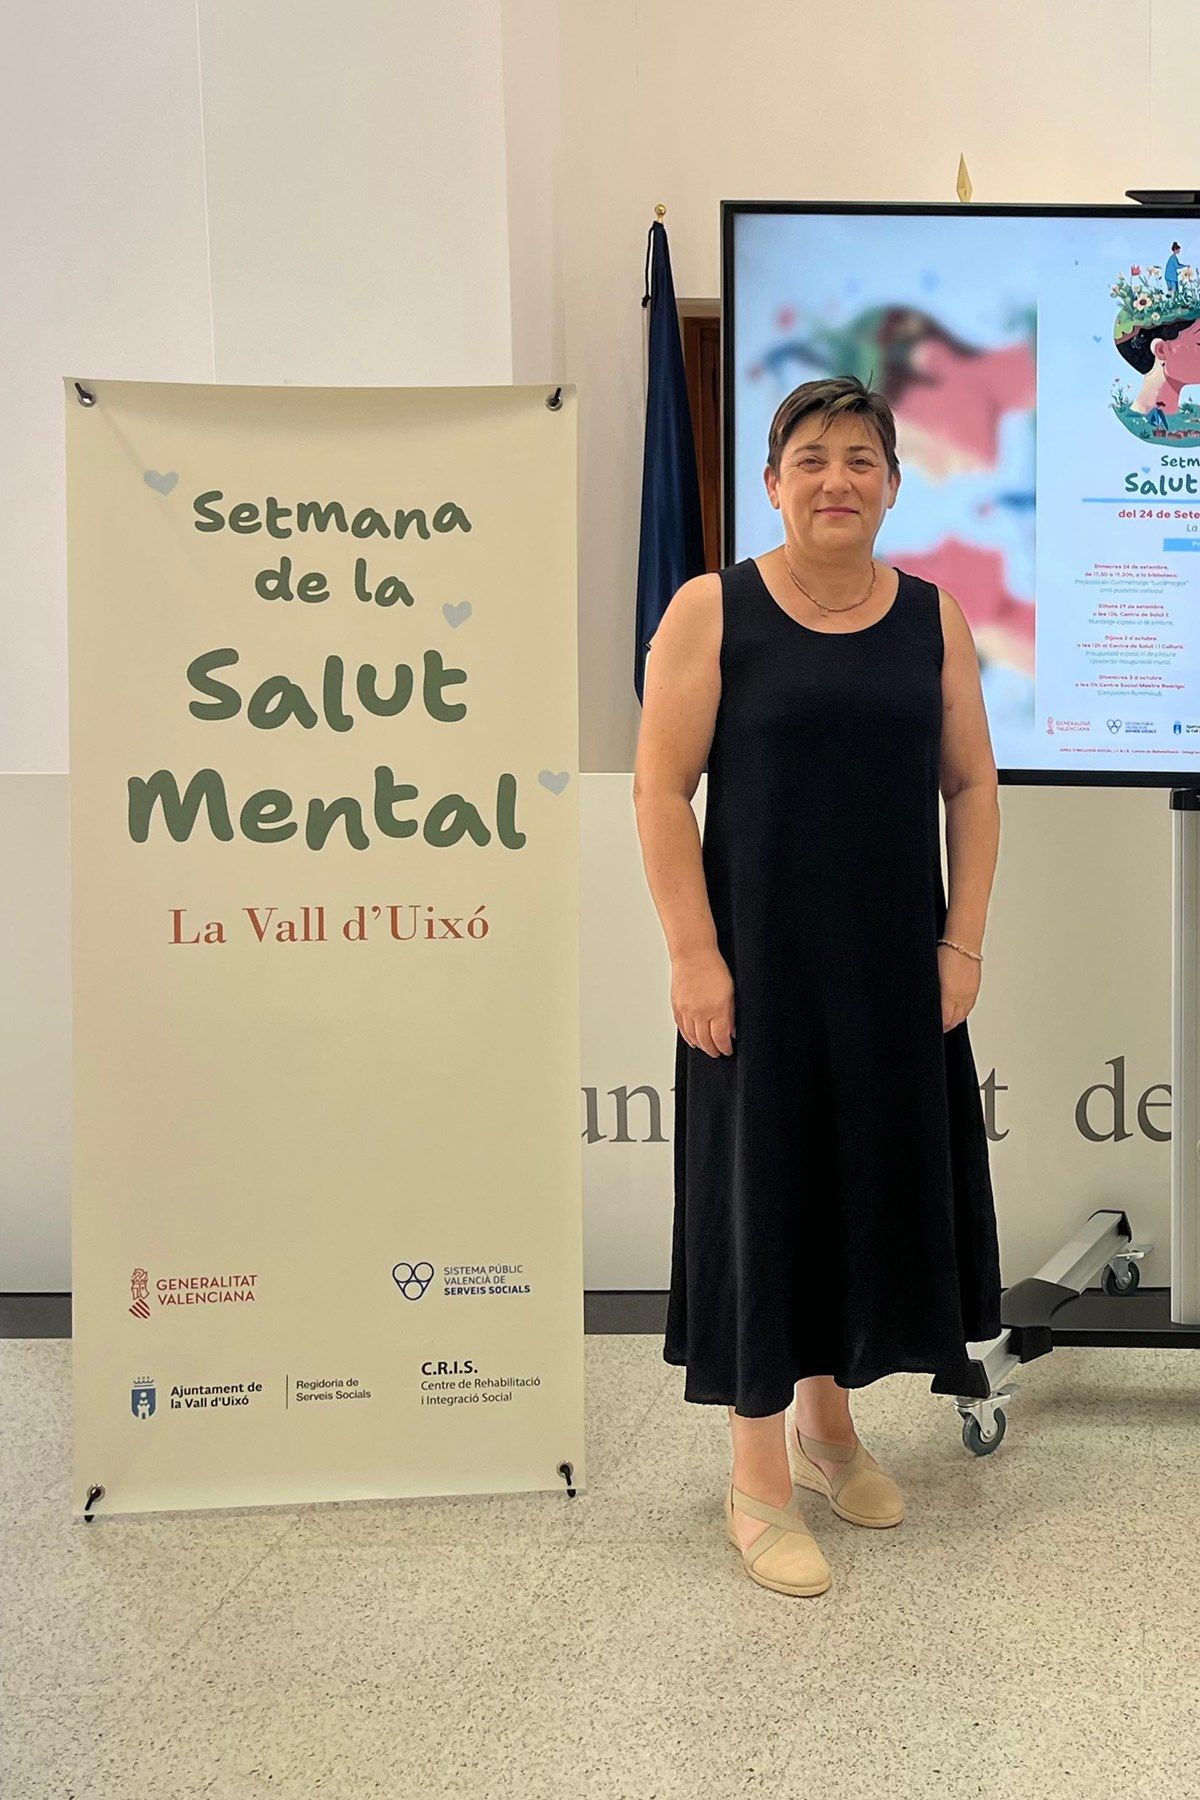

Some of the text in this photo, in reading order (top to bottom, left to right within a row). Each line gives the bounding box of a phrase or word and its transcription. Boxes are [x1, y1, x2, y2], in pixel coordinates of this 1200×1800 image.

[1125, 472, 1197, 496] Salut
[193, 489, 472, 540] Setmana
[1118, 510, 1136, 519] del
[1139, 510, 1152, 519] 24
[1157, 510, 1170, 519] de
[1186, 524, 1198, 533] La
[255, 556, 415, 607] de la
[186, 647, 468, 732] Salut
[127, 765, 527, 851] Mental
[168, 904, 490, 944] La Vall d'Uixó
[1075, 1055, 1173, 1142] de
[444, 1264, 523, 1276] SISTEMA PÚBLIC
[156, 1275, 258, 1291] GENERALITAT
[444, 1273, 506, 1285] VALENCIÀ DE
[157, 1290, 255, 1306] VALENCIANA
[444, 1285, 531, 1296] SERVEIS SOCIALS
[421, 1361, 478, 1376] C.R.I.S.
[171, 1382, 263, 1398] Ajuntament de
[296, 1378, 359, 1391] Regidoria de
[421, 1376, 541, 1391] Centre de Rehabilitació
[171, 1395, 250, 1409] la Vall d'Uixó
[296, 1390, 371, 1402] Serveis Socials
[426, 1393, 479, 1407] Integració
[481, 1392, 512, 1403] Social
